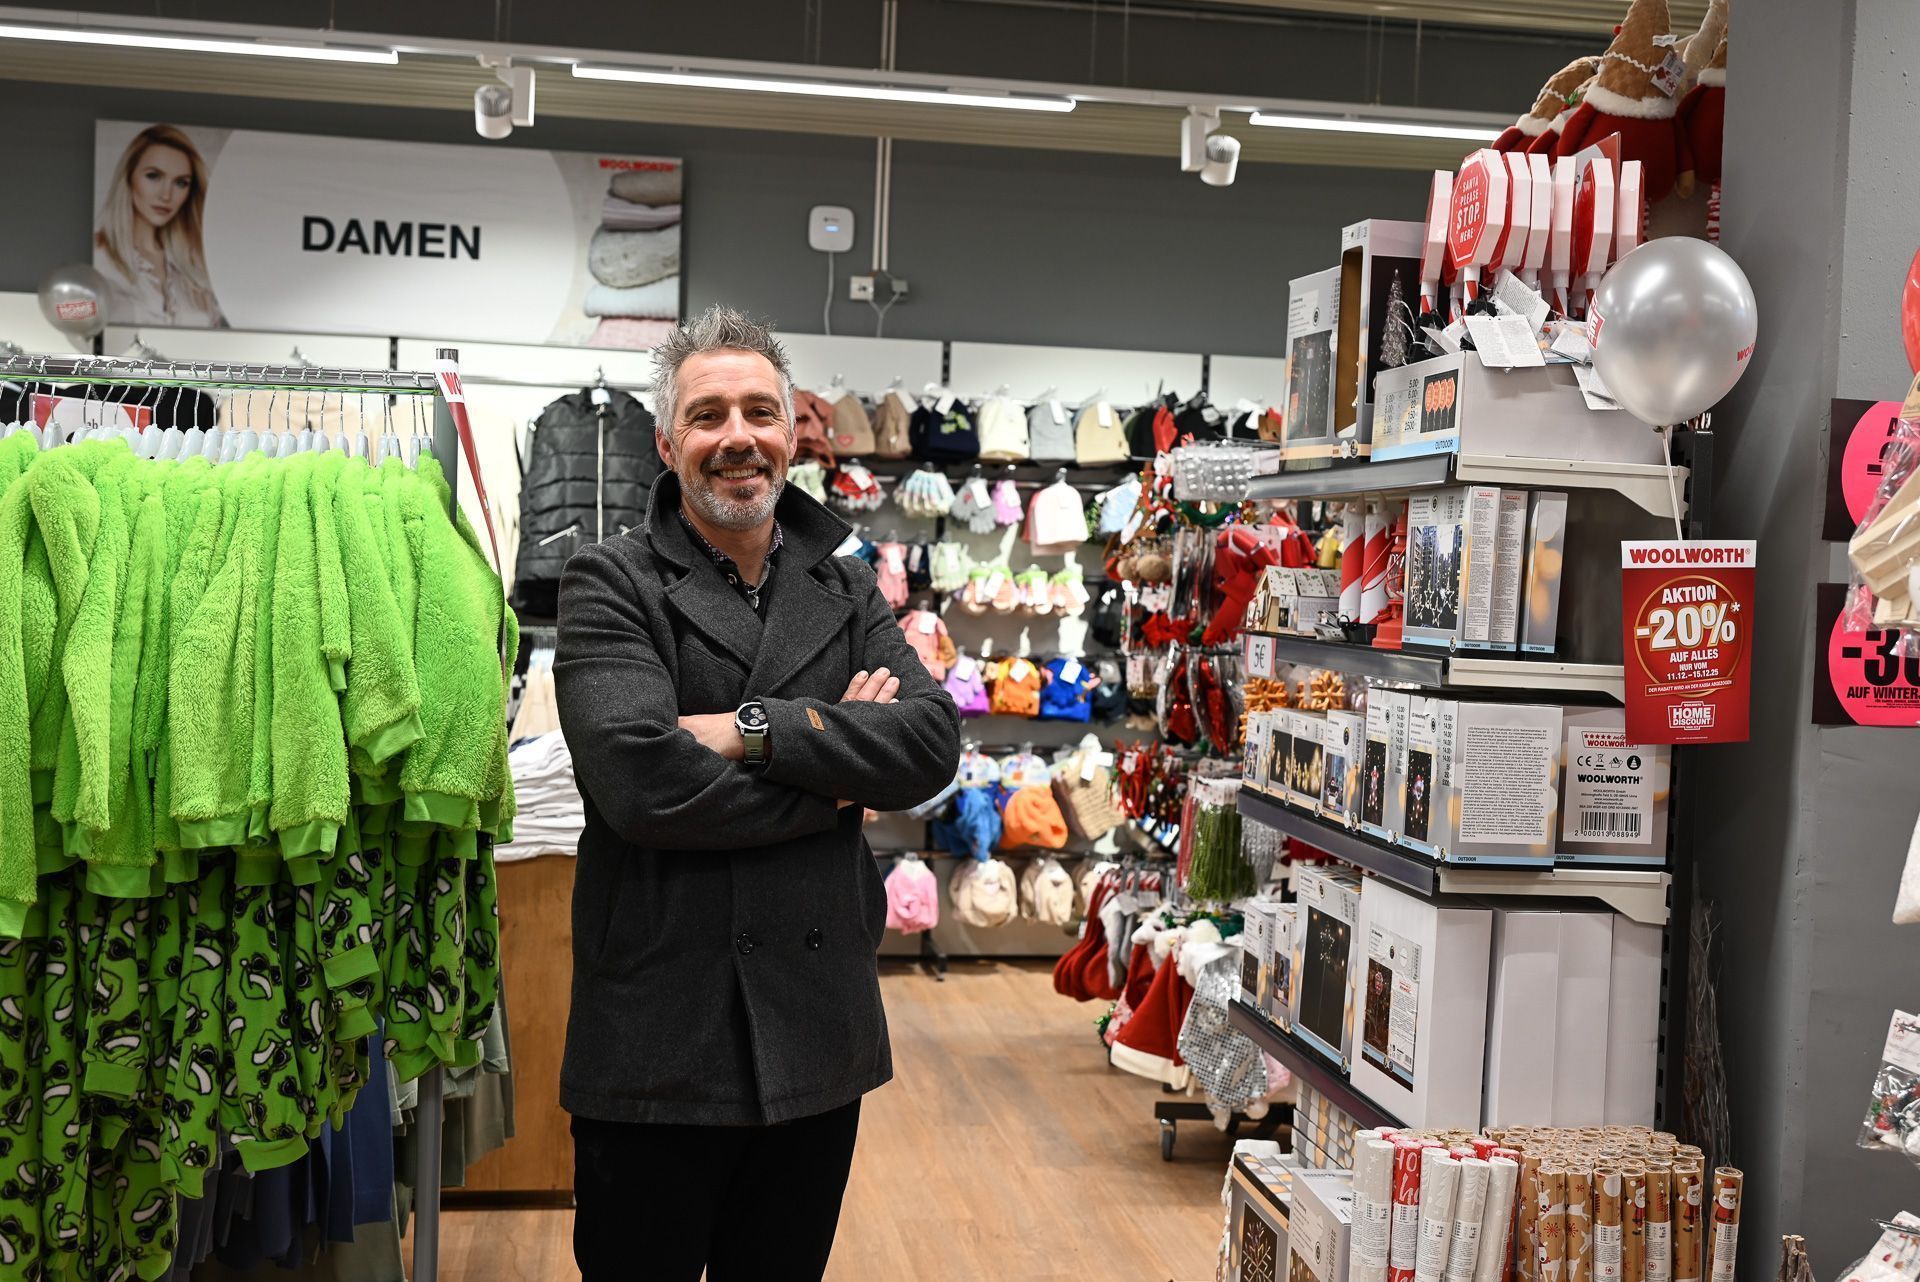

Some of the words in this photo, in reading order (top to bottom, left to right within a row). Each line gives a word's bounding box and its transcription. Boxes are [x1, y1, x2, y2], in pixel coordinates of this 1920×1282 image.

[1462, 178, 1479, 193] SANTA
[1460, 191, 1479, 206] PLEASE
[1456, 201, 1480, 230] STOP
[302, 216, 481, 260] DAMEN
[1459, 229, 1475, 243] HERE
[1661, 585, 1717, 604] AKTION
[1670, 651, 1689, 663] AUF
[1691, 648, 1719, 661] ALLES
[1679, 662, 1693, 671] NUR
[1694, 662, 1708, 670] VOM
[1847, 686, 1870, 699] AUF
[1673, 707, 1711, 719] HOME
[1672, 718, 1710, 726] DISCOUNT
